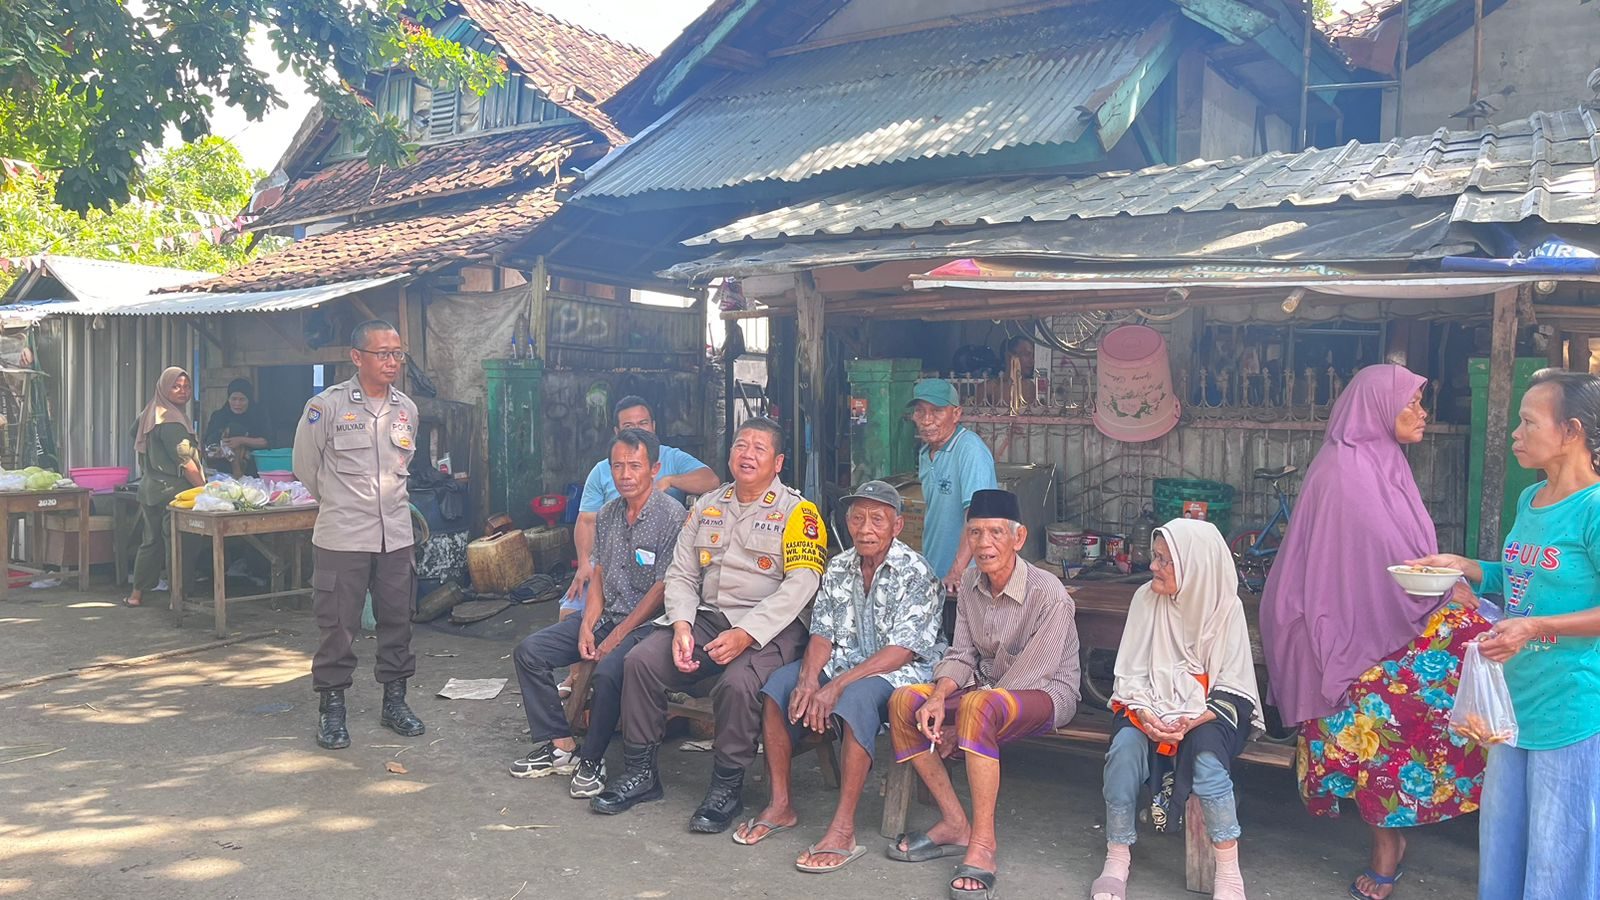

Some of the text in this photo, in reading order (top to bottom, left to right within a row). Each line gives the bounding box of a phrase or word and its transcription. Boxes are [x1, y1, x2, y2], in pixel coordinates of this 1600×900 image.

[336, 422, 366, 433] MULYADI
[392, 423, 414, 433] POLR
[38, 499, 57, 508] 2020
